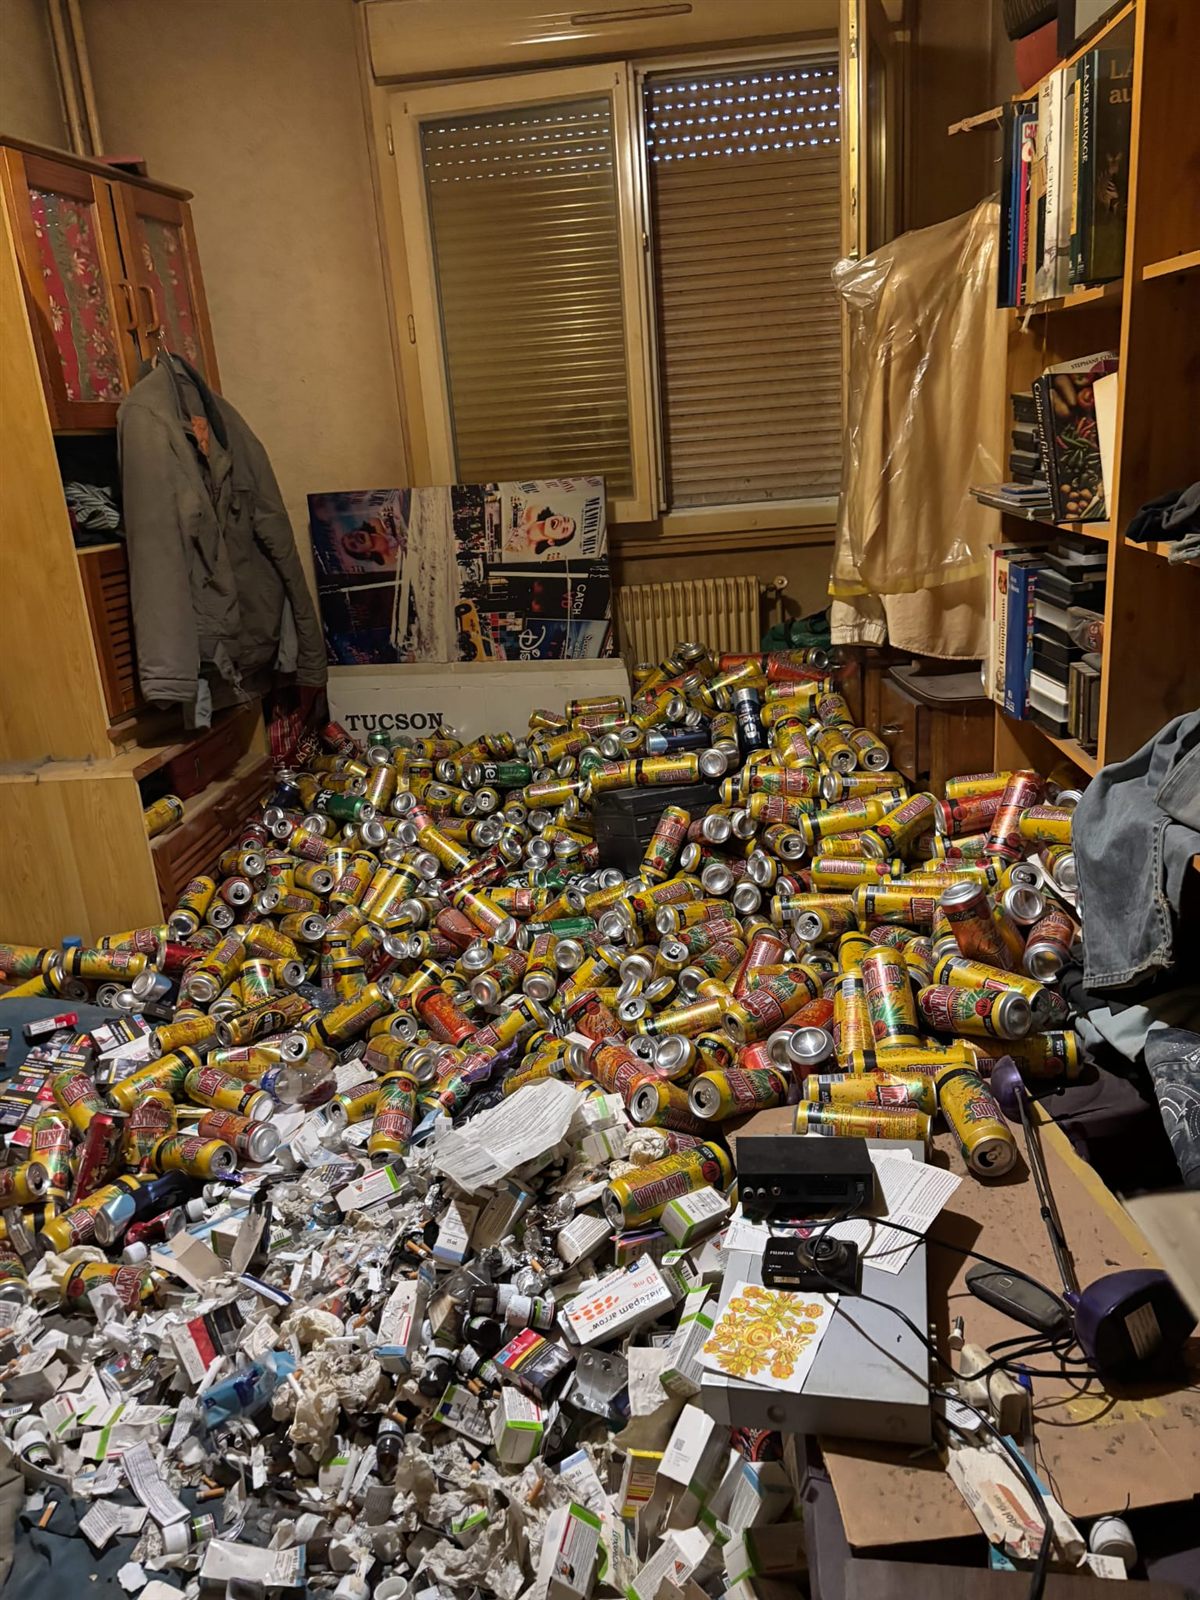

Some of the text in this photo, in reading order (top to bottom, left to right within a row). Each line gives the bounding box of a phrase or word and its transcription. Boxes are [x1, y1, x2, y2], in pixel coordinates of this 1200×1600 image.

[571, 583, 586, 616] CATCH
[345, 712, 444, 732] TUCSON
[633, 1173, 687, 1210] DESPERADOS
[592, 1311, 618, 1330] arrow
